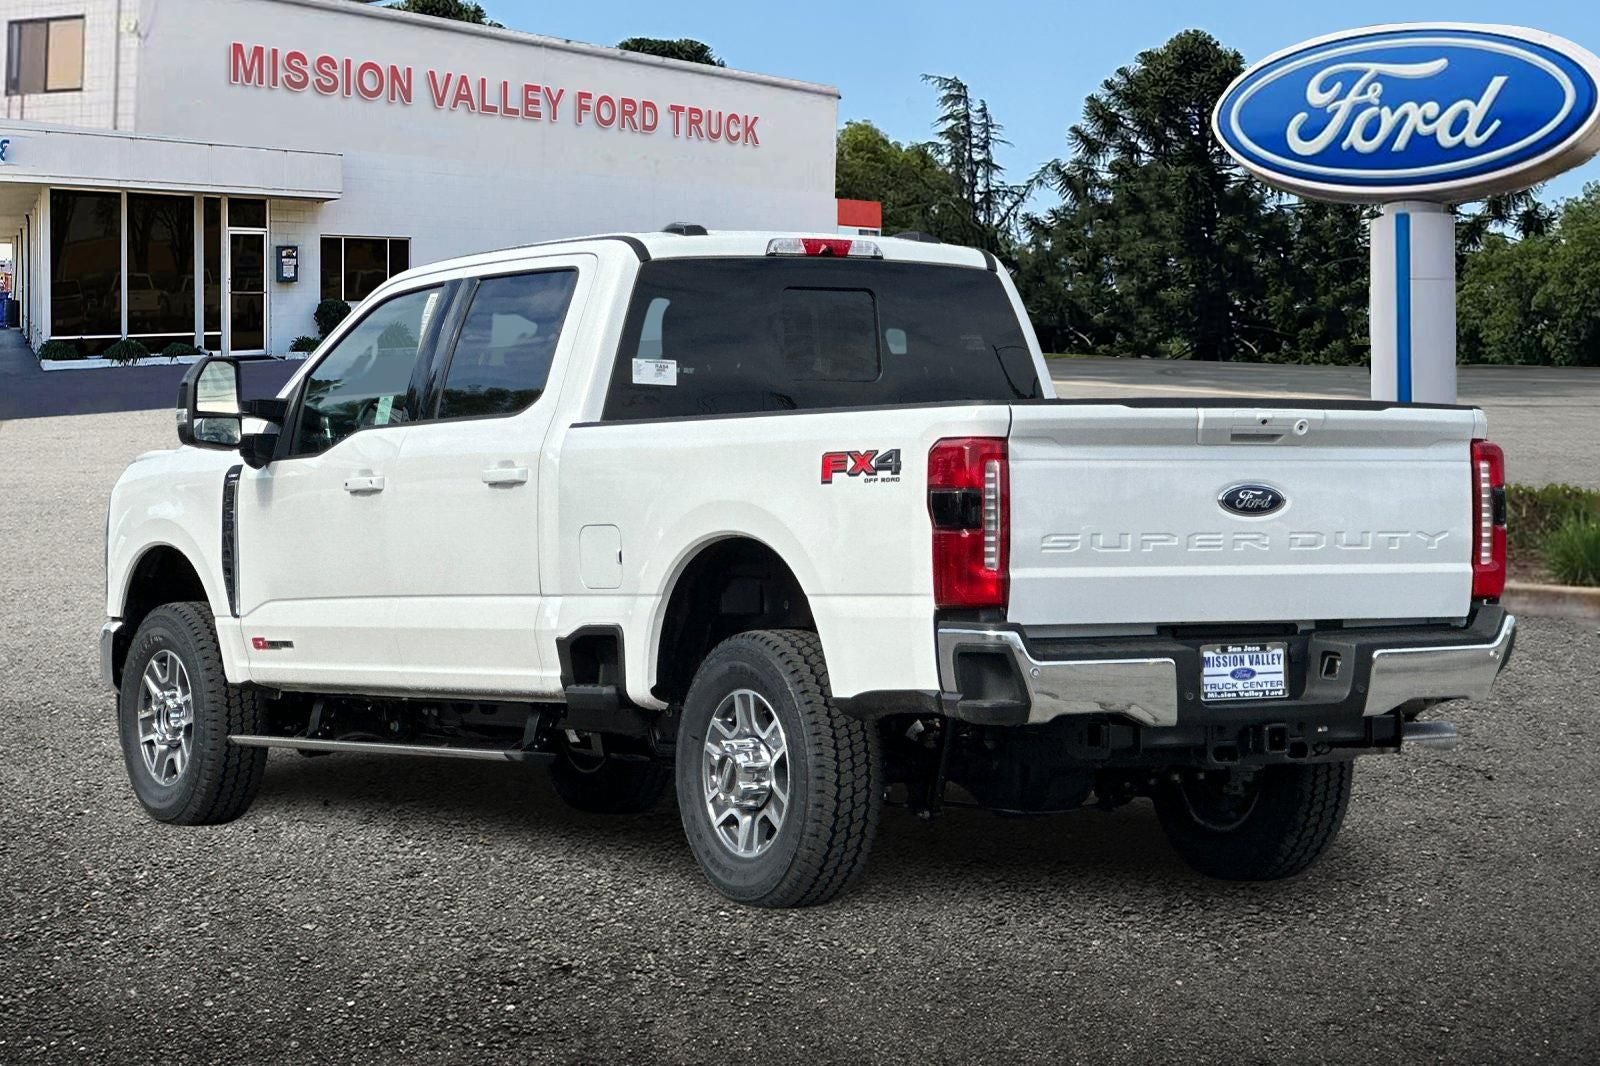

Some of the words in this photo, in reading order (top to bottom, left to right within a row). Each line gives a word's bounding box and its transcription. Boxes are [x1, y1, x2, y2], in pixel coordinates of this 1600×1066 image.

[229, 41, 413, 104] MISSION
[427, 69, 565, 122] VALLEY
[576, 91, 660, 134] FORD
[669, 104, 761, 145] TRUCK
[1286, 57, 1509, 156] Ford
[820, 448, 902, 485] FX4
[1235, 489, 1272, 509] Ford
[1041, 532, 1270, 553] SUPER
[1289, 531, 1449, 550] DUTY
[1203, 654, 1245, 668] MISSION
[1248, 653, 1282, 666] VALLEY
[1234, 669, 1252, 679] Ford
[1242, 680, 1283, 689] CENTER
